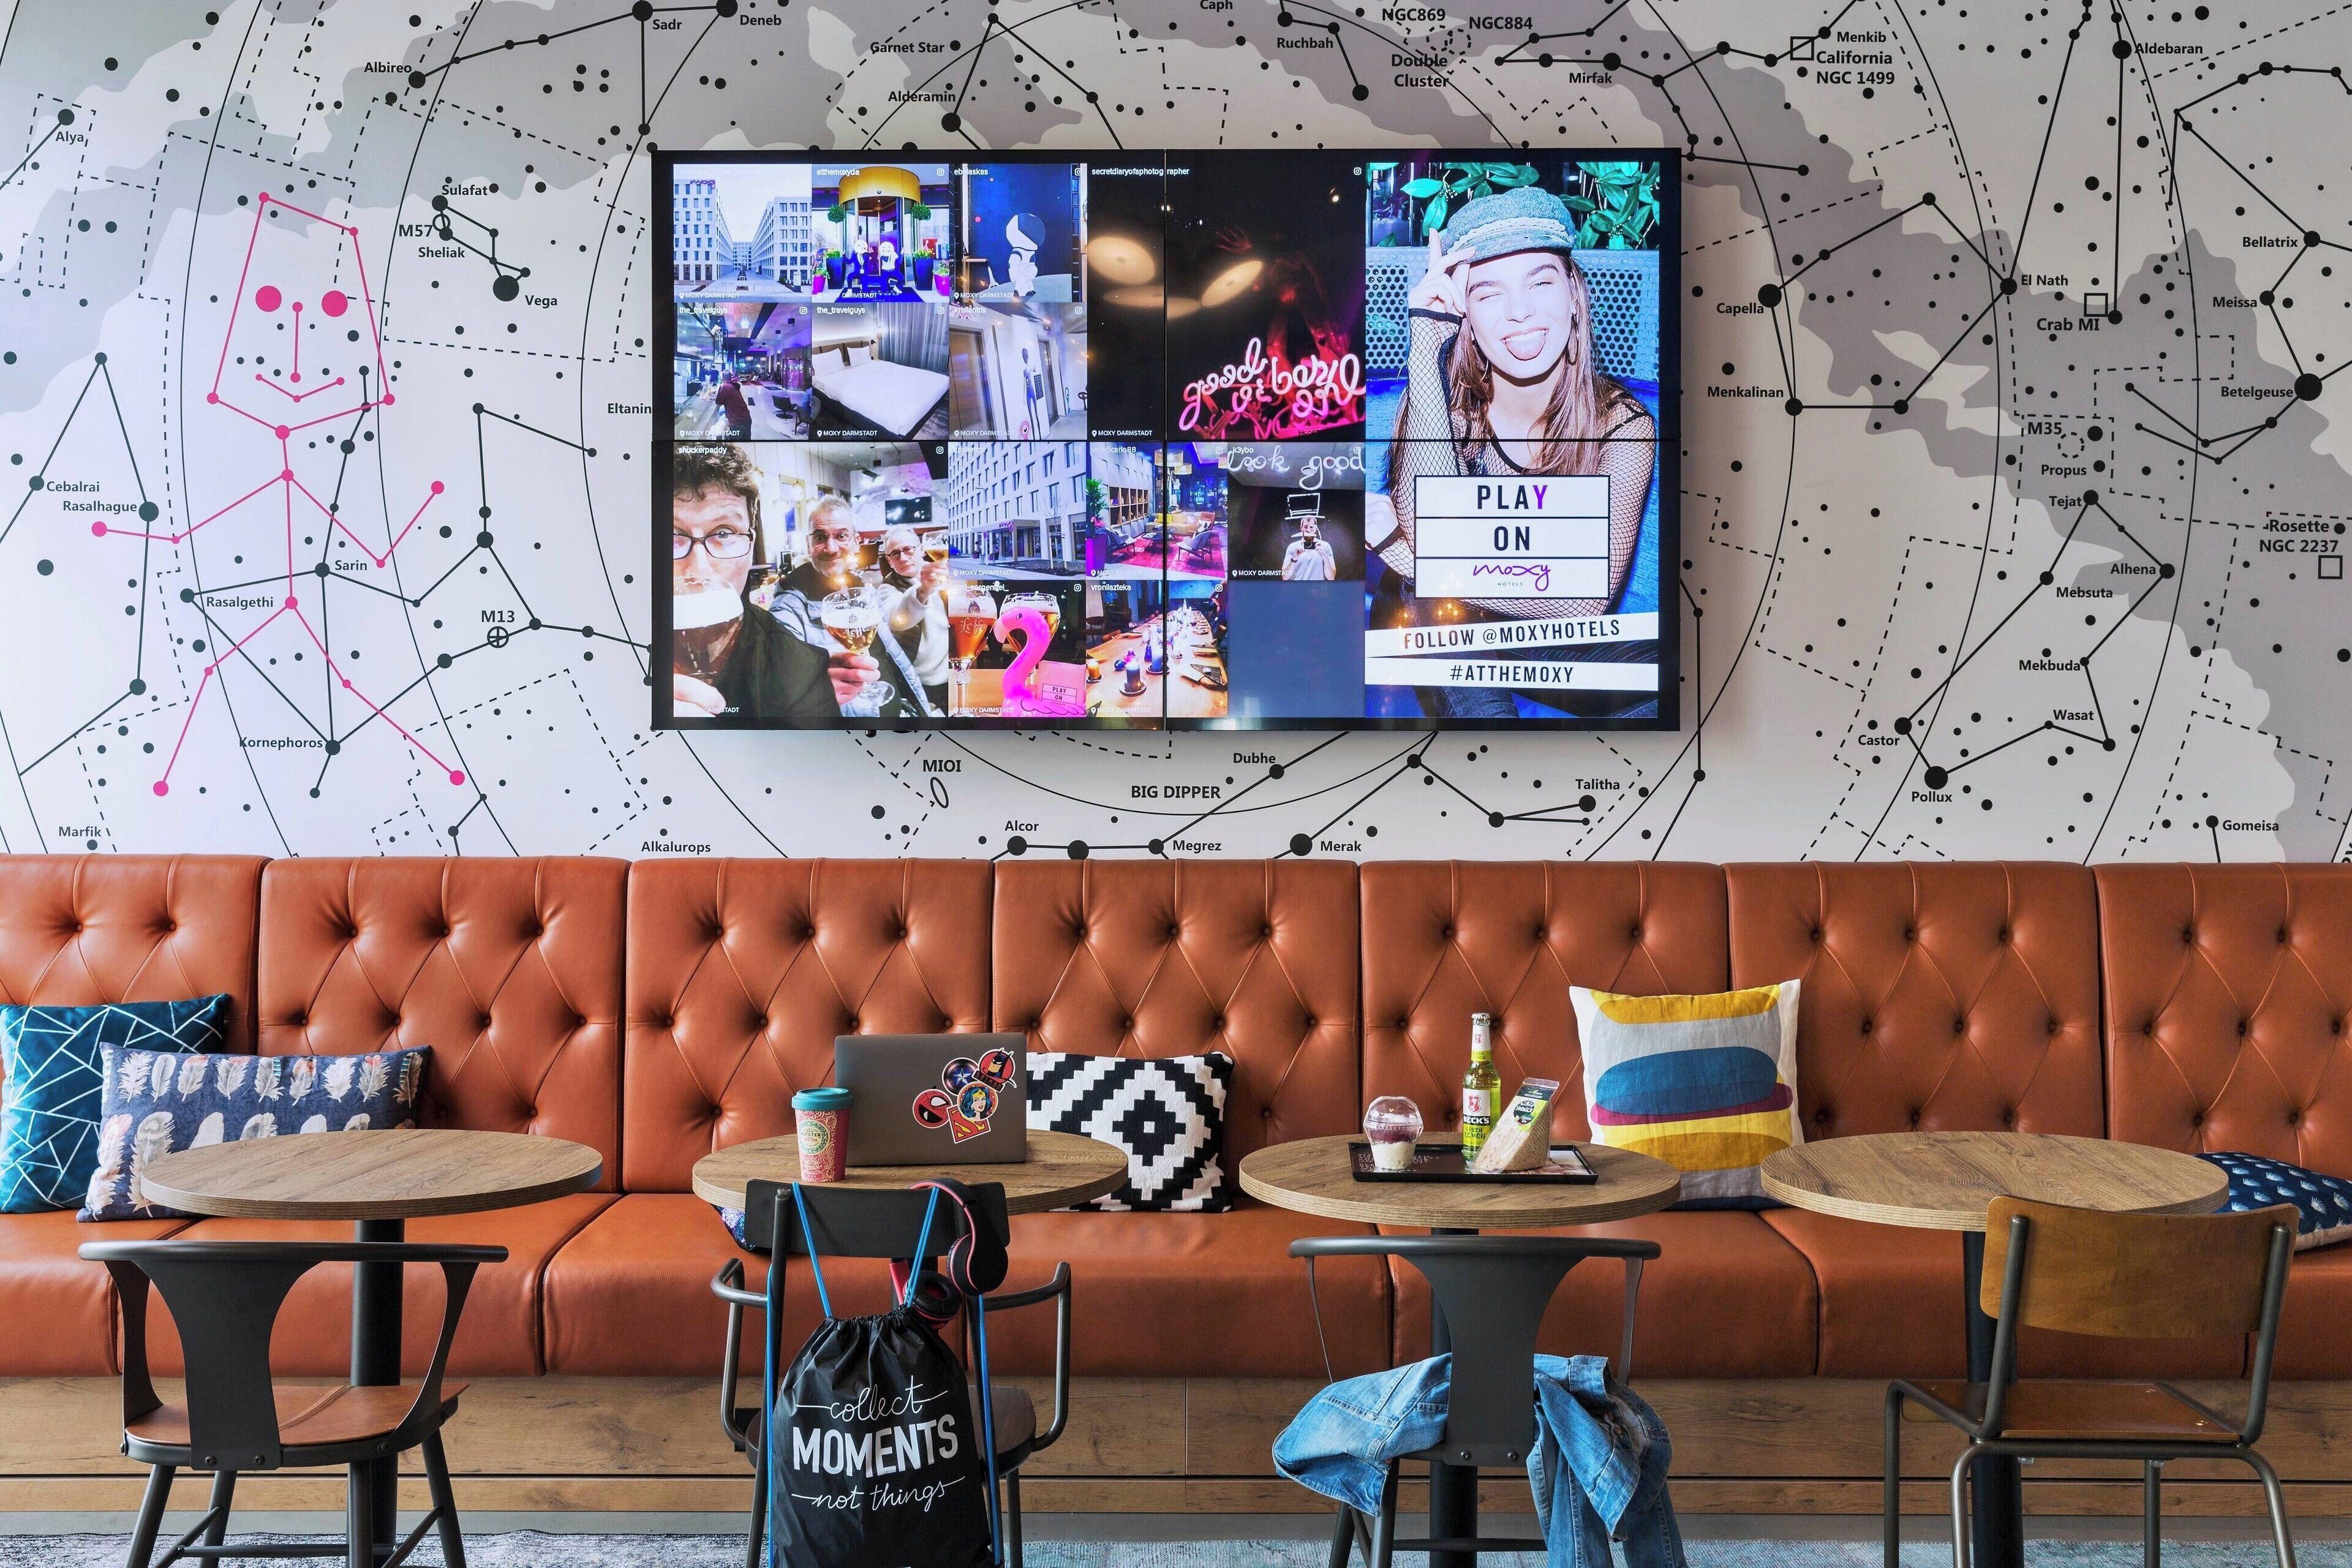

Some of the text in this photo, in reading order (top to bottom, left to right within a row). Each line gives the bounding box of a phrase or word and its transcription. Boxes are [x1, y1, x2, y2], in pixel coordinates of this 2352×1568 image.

[1200, 0, 1233, 13] Caph
[740, 14, 782, 26] Deneb
[1382, 8, 1446, 22] NGC869
[652, 18, 682, 30] Sadr
[1469, 16, 1533, 30] NGC884
[1277, 37, 1333, 48] Ruchbah
[1837, 31, 1887, 43] Menkib
[870, 42, 945, 54] Garnet Star
[2134, 42, 2204, 55] Aldebaran
[1391, 54, 1449, 68] Double
[1816, 50, 1893, 64] California
[364, 61, 412, 74] Albireo
[1393, 74, 1450, 88] Cluster
[1569, 72, 1613, 84] Mirfak
[1817, 71, 1895, 85] NGC 1499
[888, 90, 956, 102] Alderamin
[55, 130, 85, 144] Alya
[442, 184, 488, 196] Sulafat
[399, 224, 434, 238] M57
[2242, 236, 2298, 247] Bellatrix
[418, 246, 465, 258] Sheliak
[2021, 274, 2068, 286] El Nath
[525, 295, 557, 309] Vega
[2213, 296, 2257, 307] Meissa
[816, 306, 866, 315] the_travelguys
[1716, 302, 1764, 317] Capella
[1707, 386, 1784, 398] Menkalinan
[2221, 386, 2293, 401] Betelgeuse
[608, 402, 652, 414] Eltanin
[2027, 421, 2063, 435] M35
[678, 446, 728, 455] shuckerpaddy
[2041, 464, 2087, 478] Propus
[47, 481, 99, 492] Cebalrai
[1477, 484, 1548, 510] PLAY
[2049, 495, 2082, 510] Tejat
[63, 500, 137, 515] Rasalhague
[2269, 519, 2330, 533] Rosette
[1493, 526, 1531, 551] ON
[2260, 539, 2339, 553] NGC 2237
[335, 560, 368, 571] Sarin
[2110, 563, 2156, 575] Alhena
[1472, 564, 1551, 592] moxy
[2056, 586, 2113, 598] Mebsuta
[206, 596, 273, 611] Rasalgethi
[481, 610, 515, 623] M13
[1403, 619, 1621, 650] FOLLOW @MOXYHOTELS
[2019, 659, 2081, 671] Mekbuda
[1449, 665, 1574, 684] #ATTHEMOXY
[2052, 709, 2094, 721] Wasat
[238, 736, 323, 752] Kornephoros
[1858, 734, 1900, 746] Castor
[1233, 752, 1276, 764] Dubhe
[1575, 778, 1620, 790] Talitha
[1131, 785, 1221, 799] BIG DIPPER
[1912, 791, 1953, 802] Pollux
[59, 826, 101, 837] Marfik
[1005, 820, 1039, 831] Alcor
[2222, 820, 2279, 831] Gomeisa
[641, 840, 711, 856] Alkalurops
[1173, 840, 1222, 854] Megrez
[1321, 840, 1362, 852] Merak
[1463, 1115, 1490, 1125] BECK'S
[796, 1375, 948, 1422] collect
[793, 1413, 959, 1479] MOMENTS
[792, 1476, 966, 1513] not things
